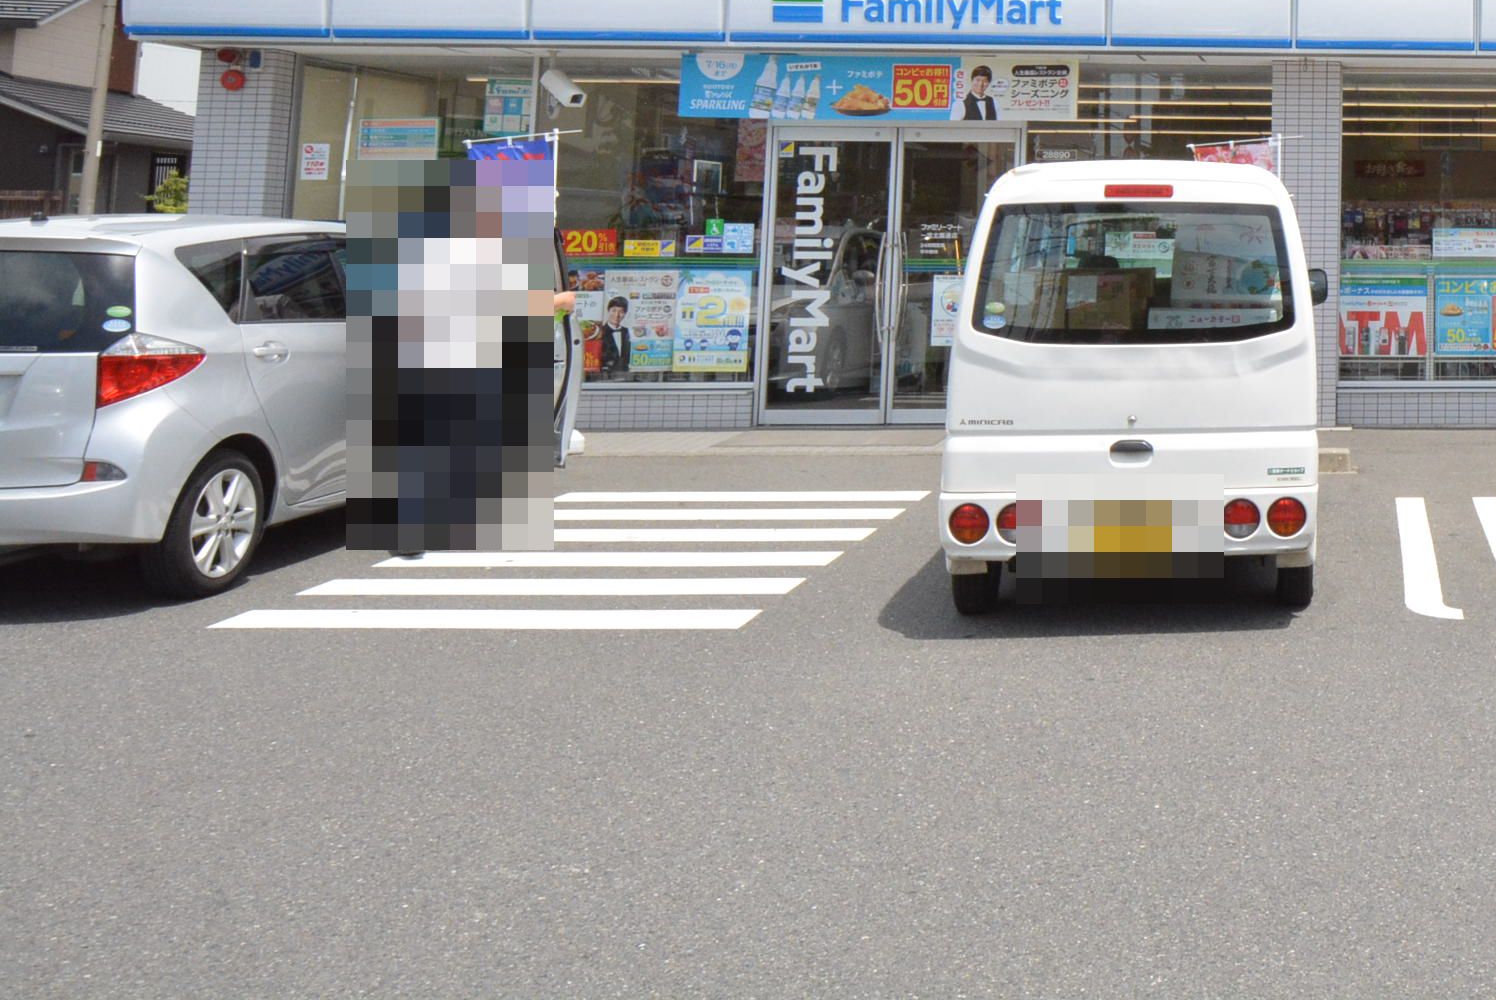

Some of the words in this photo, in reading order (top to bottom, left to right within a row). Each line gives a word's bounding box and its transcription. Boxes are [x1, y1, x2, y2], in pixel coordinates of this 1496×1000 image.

[895, 67, 949, 77] コンビでお得!!
[1011, 78, 1058, 88] ファミポテ
[1010, 89, 1070, 99] シーズニング
[689, 98, 746, 110] SPARKLING
[781, 146, 839, 393] FamilyMart
